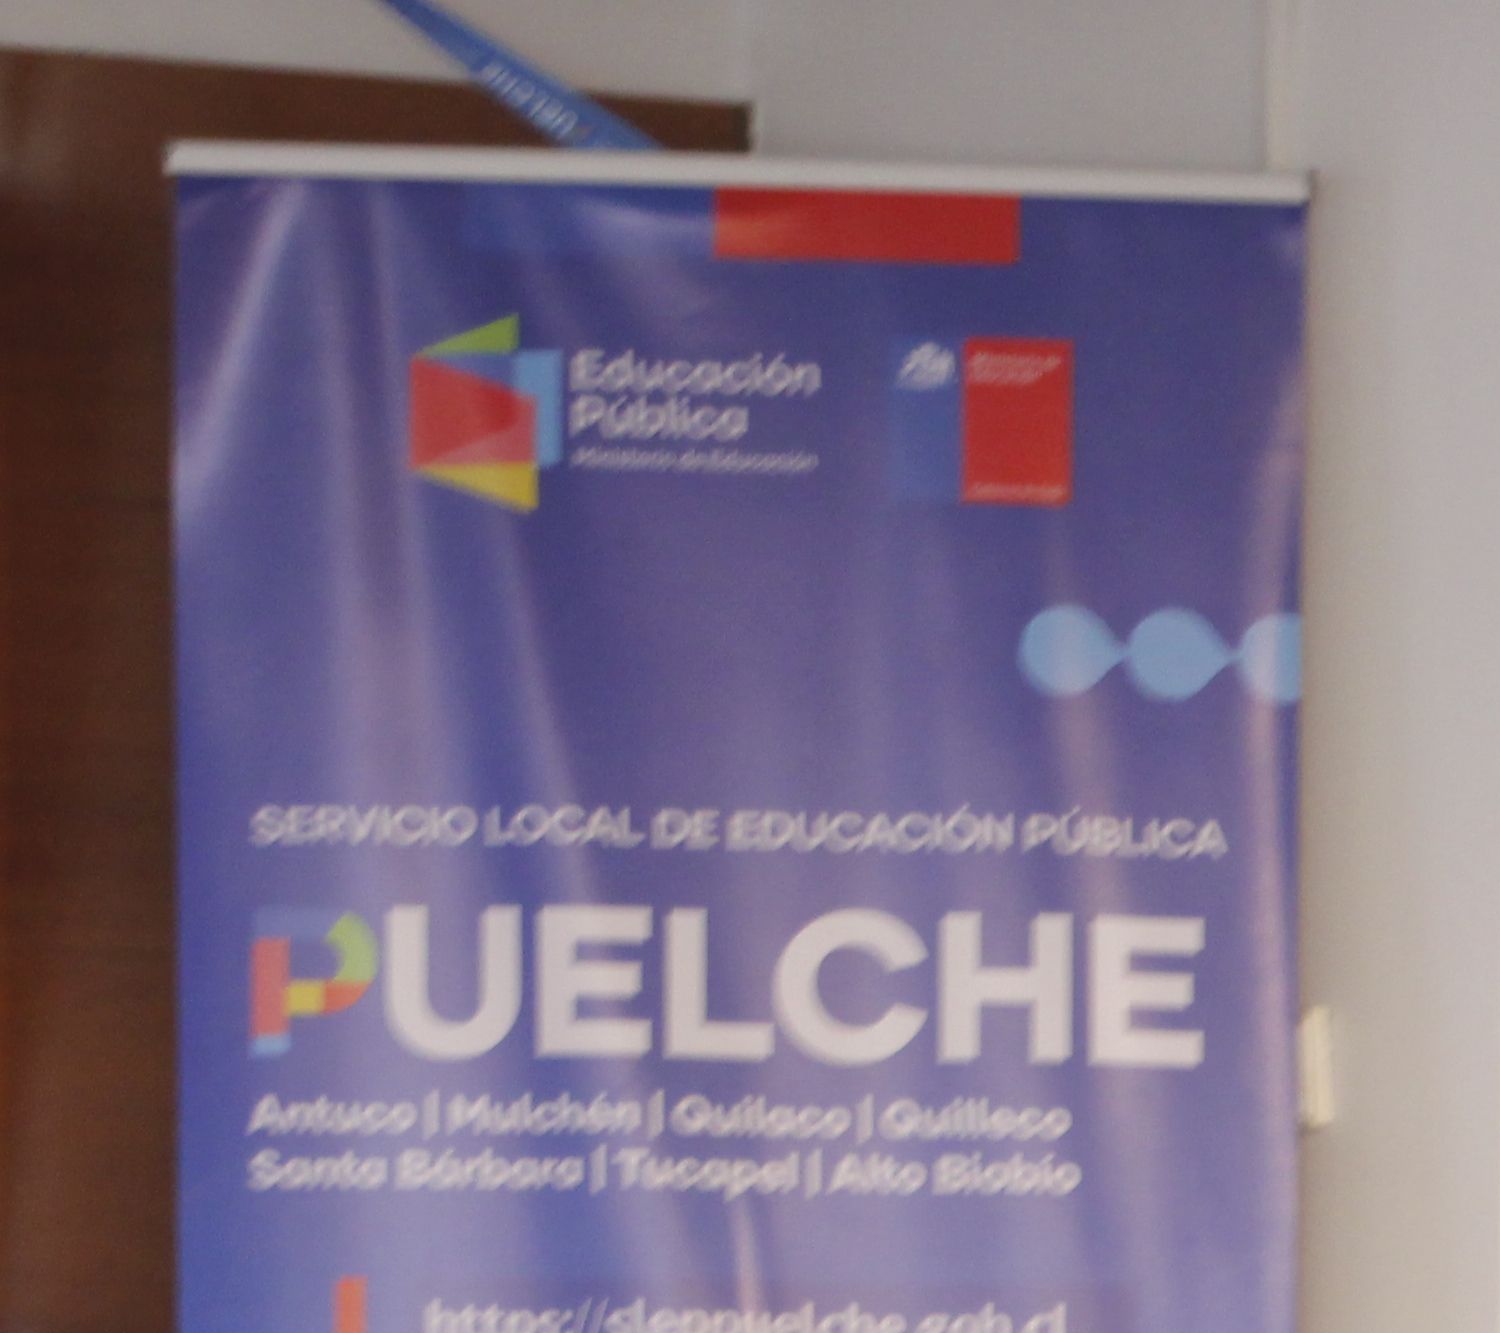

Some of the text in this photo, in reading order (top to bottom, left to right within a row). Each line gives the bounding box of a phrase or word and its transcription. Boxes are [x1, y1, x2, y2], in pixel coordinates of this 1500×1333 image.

[568, 349, 822, 397] Educación
[568, 395, 749, 442] Pública
[250, 803, 1229, 861] SERVICIO LOCAL DE EDUCACIÓN PÚBLICA
[249, 903, 1205, 1067] PUELCHE
[247, 1092, 418, 1136] Antuco
[445, 1090, 642, 1137] Mulchén
[670, 1094, 851, 1139] Quilaco
[878, 1096, 1073, 1142] Quilleco
[247, 1147, 388, 1192] Santa
[396, 1147, 586, 1192] Bárbara
[611, 1146, 799, 1203] Tucapel
[826, 1152, 928, 1195] Alto
[933, 1151, 1082, 1196] Biobío
